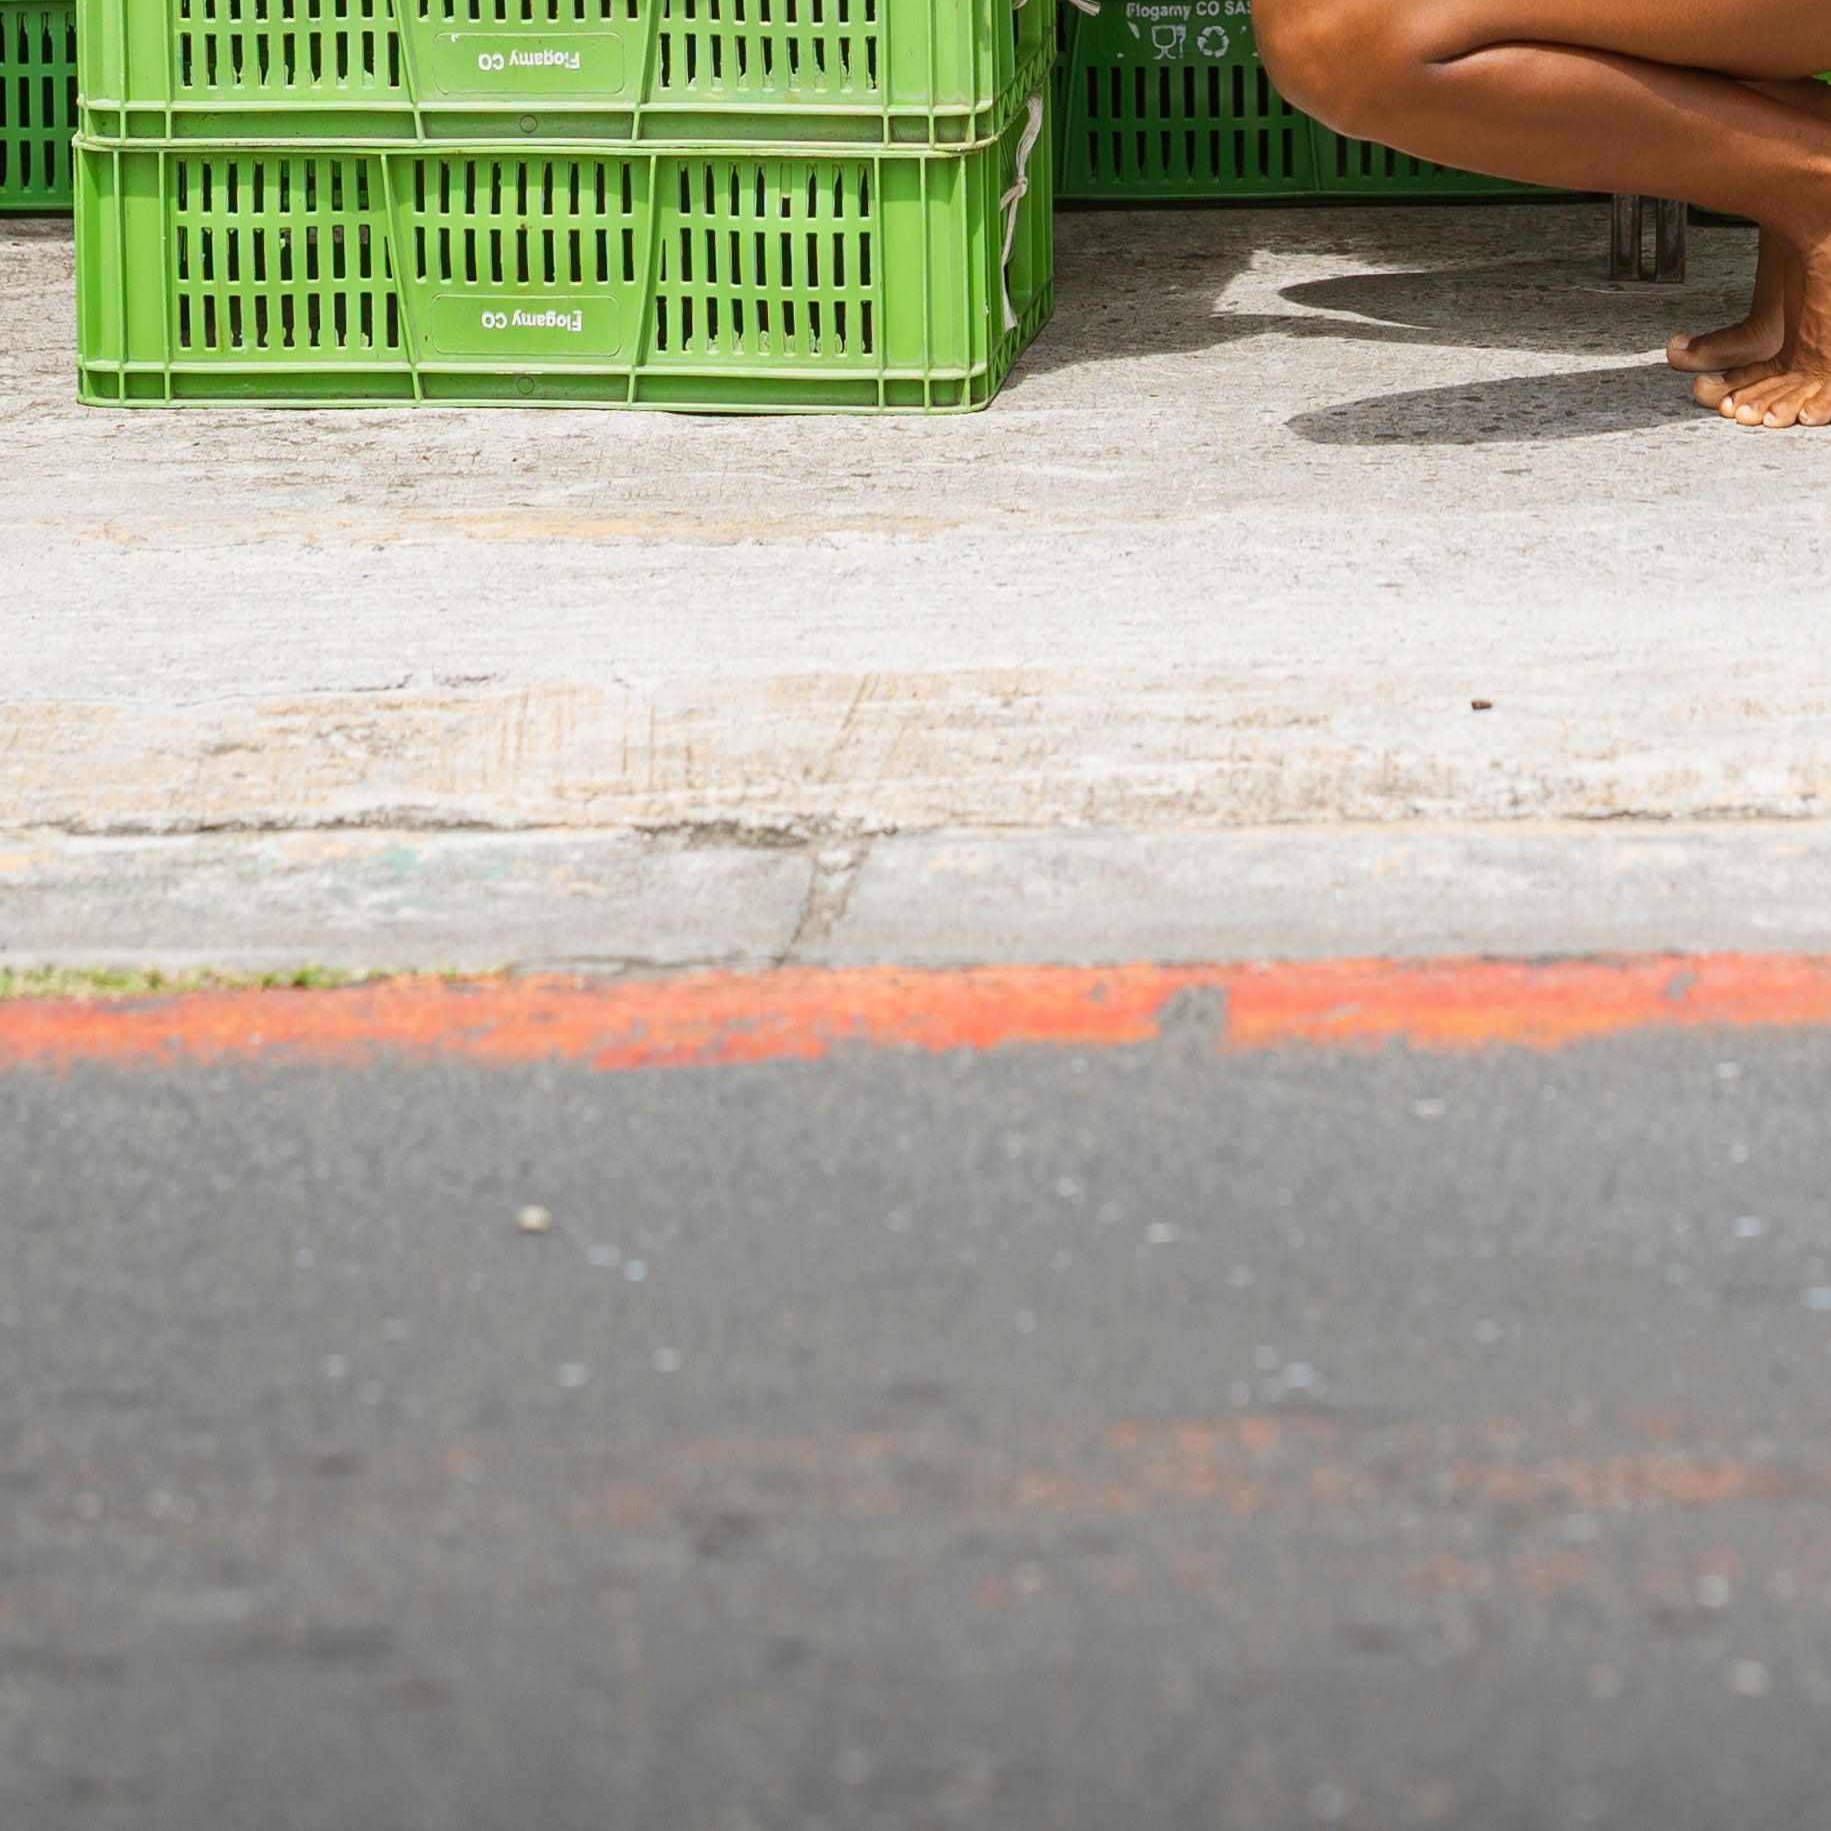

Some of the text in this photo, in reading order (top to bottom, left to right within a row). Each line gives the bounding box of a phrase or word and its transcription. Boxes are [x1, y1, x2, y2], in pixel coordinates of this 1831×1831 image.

[1126, 1, 1191, 22] Flogamy
[1196, 0, 1220, 17] CO
[478, 52, 505, 71] CO
[480, 308, 583, 332] Flogamy CO
